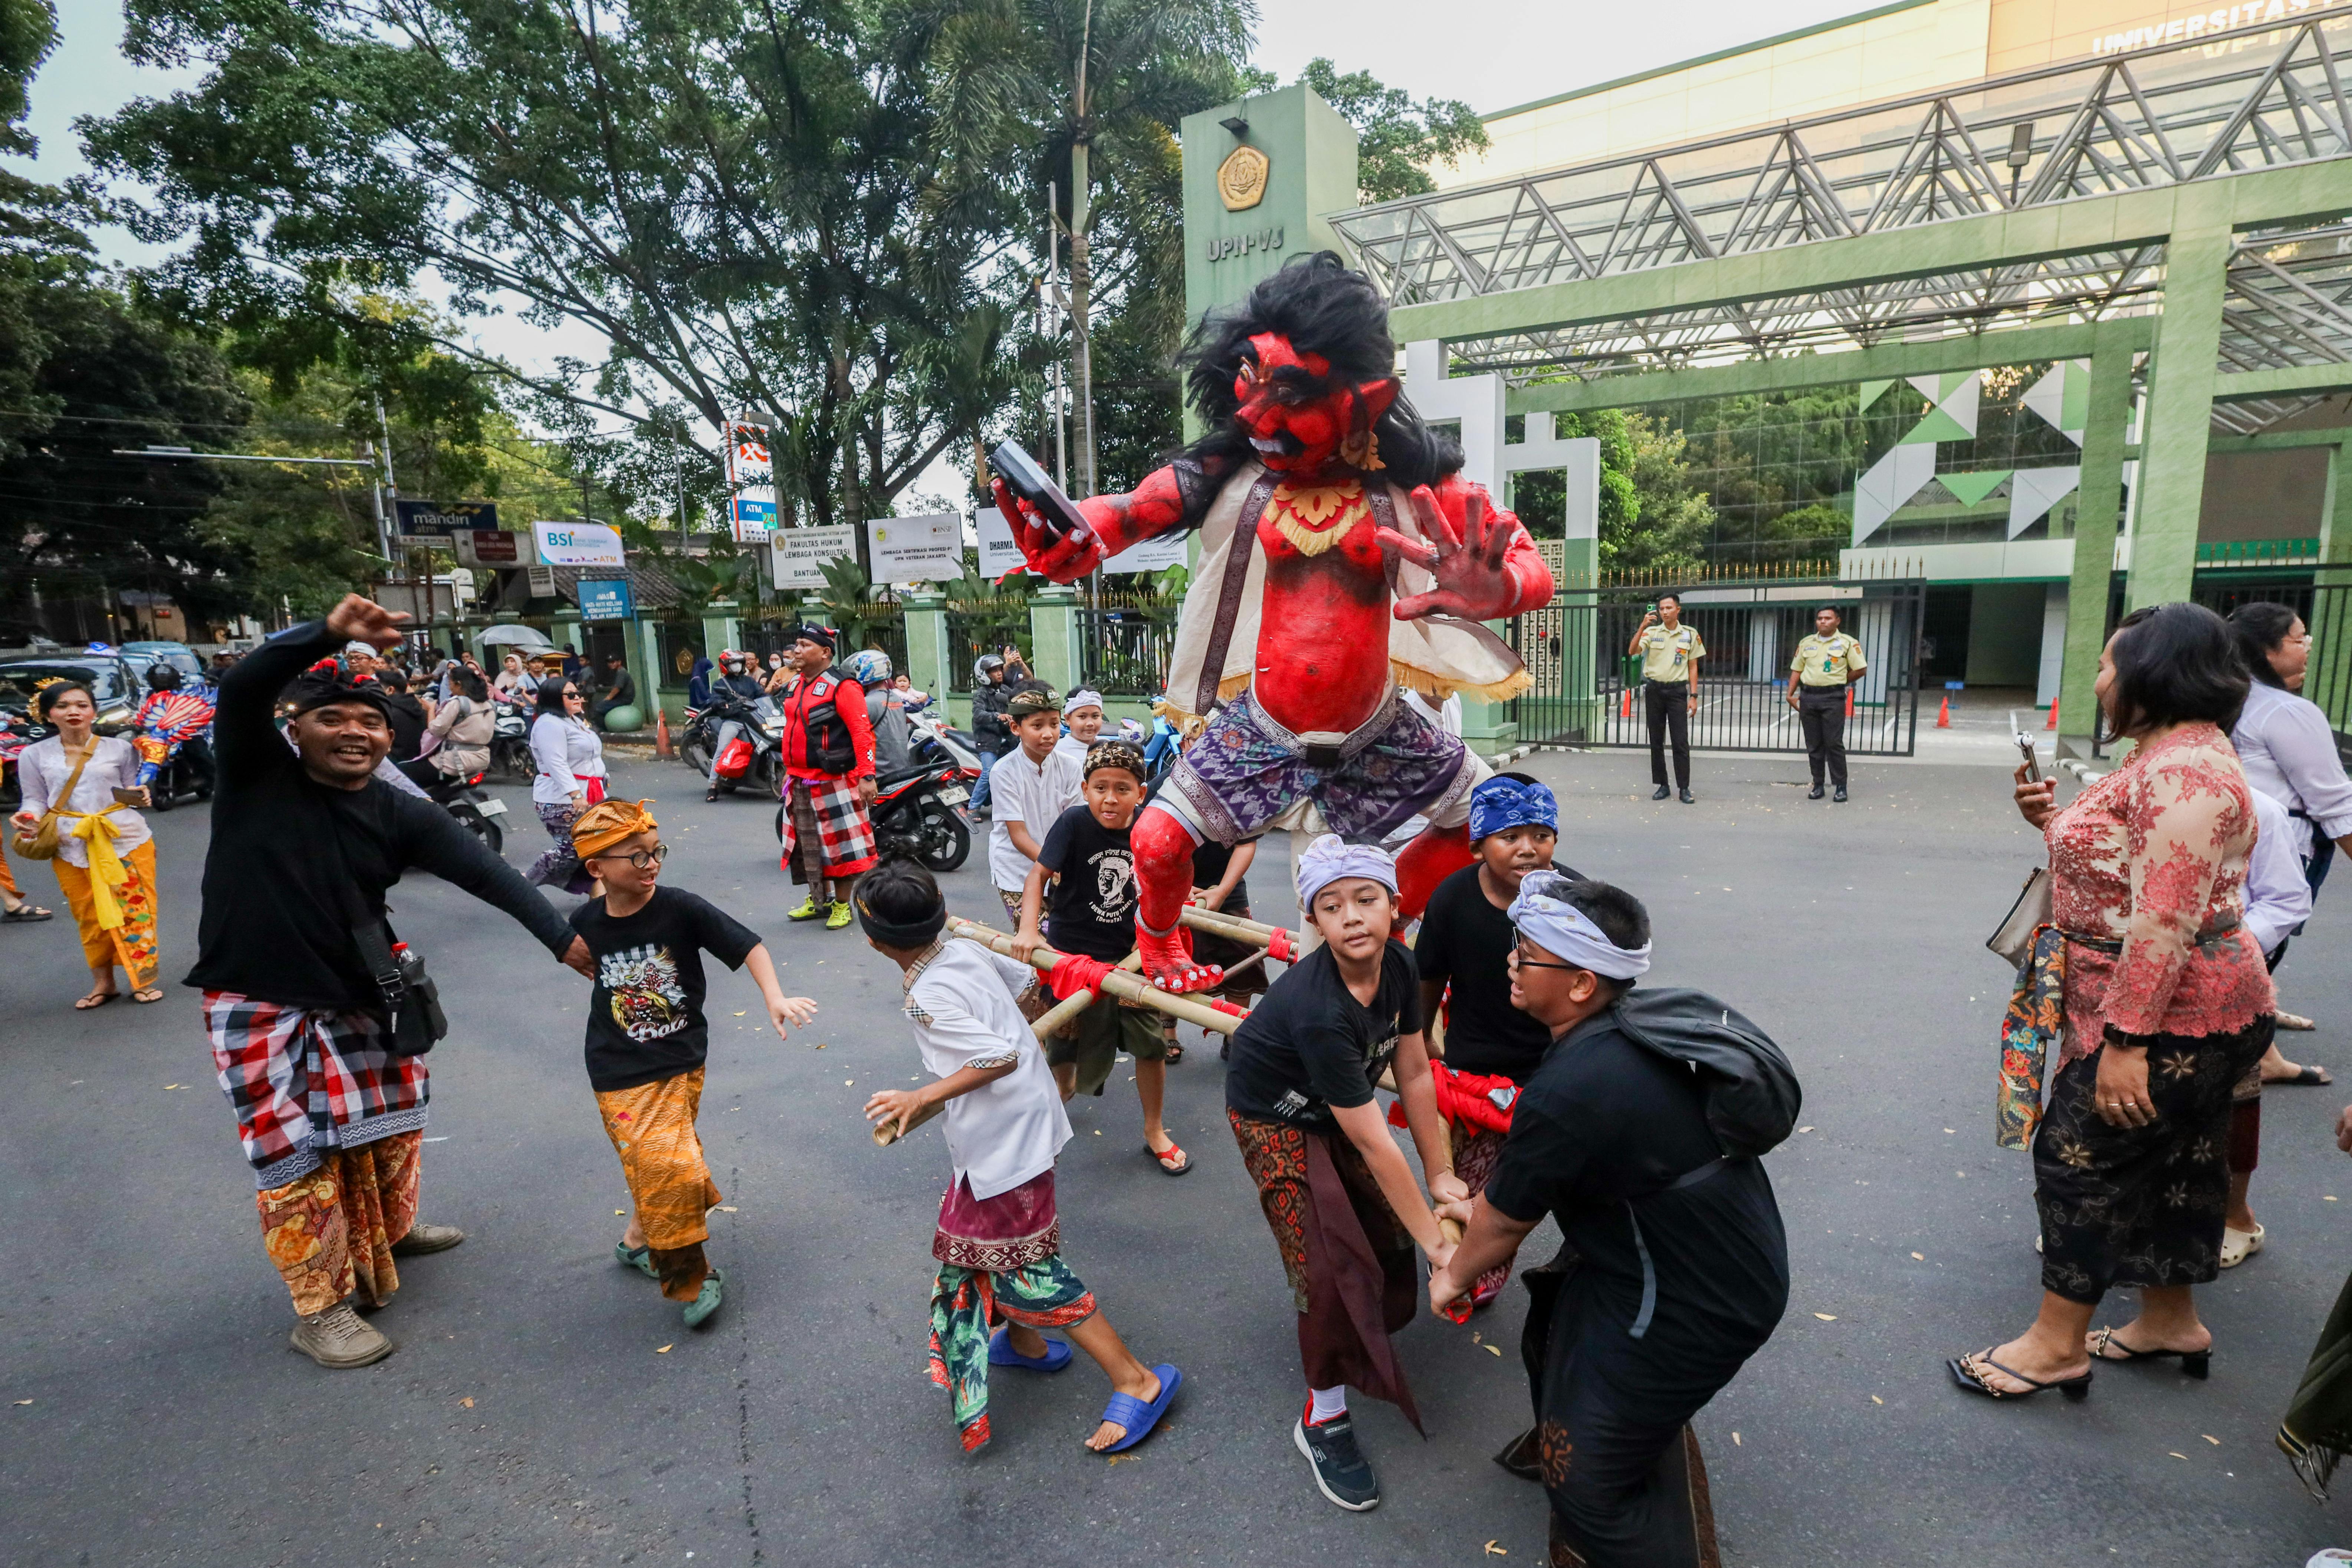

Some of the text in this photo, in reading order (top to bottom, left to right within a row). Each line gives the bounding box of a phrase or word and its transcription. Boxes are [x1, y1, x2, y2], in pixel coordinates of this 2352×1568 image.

[2092, 0, 2310, 55] UNIVERSITAS
[1207, 227, 1284, 262] UPN-VJ
[746, 504, 762, 513] ATM
[413, 513, 470, 525] mandiri
[763, 513, 775, 524] 24
[415, 525, 437, 533] atm
[547, 531, 574, 546] BSI
[790, 539, 842, 548] FAKULTAS HUKUM
[989, 540, 1013, 550] DHARMA
[785, 548, 850, 559] LEMBAGA KONSULTASI
[1091, 904, 1105, 917] DEWA
[627, 1014, 687, 1041] Bali
